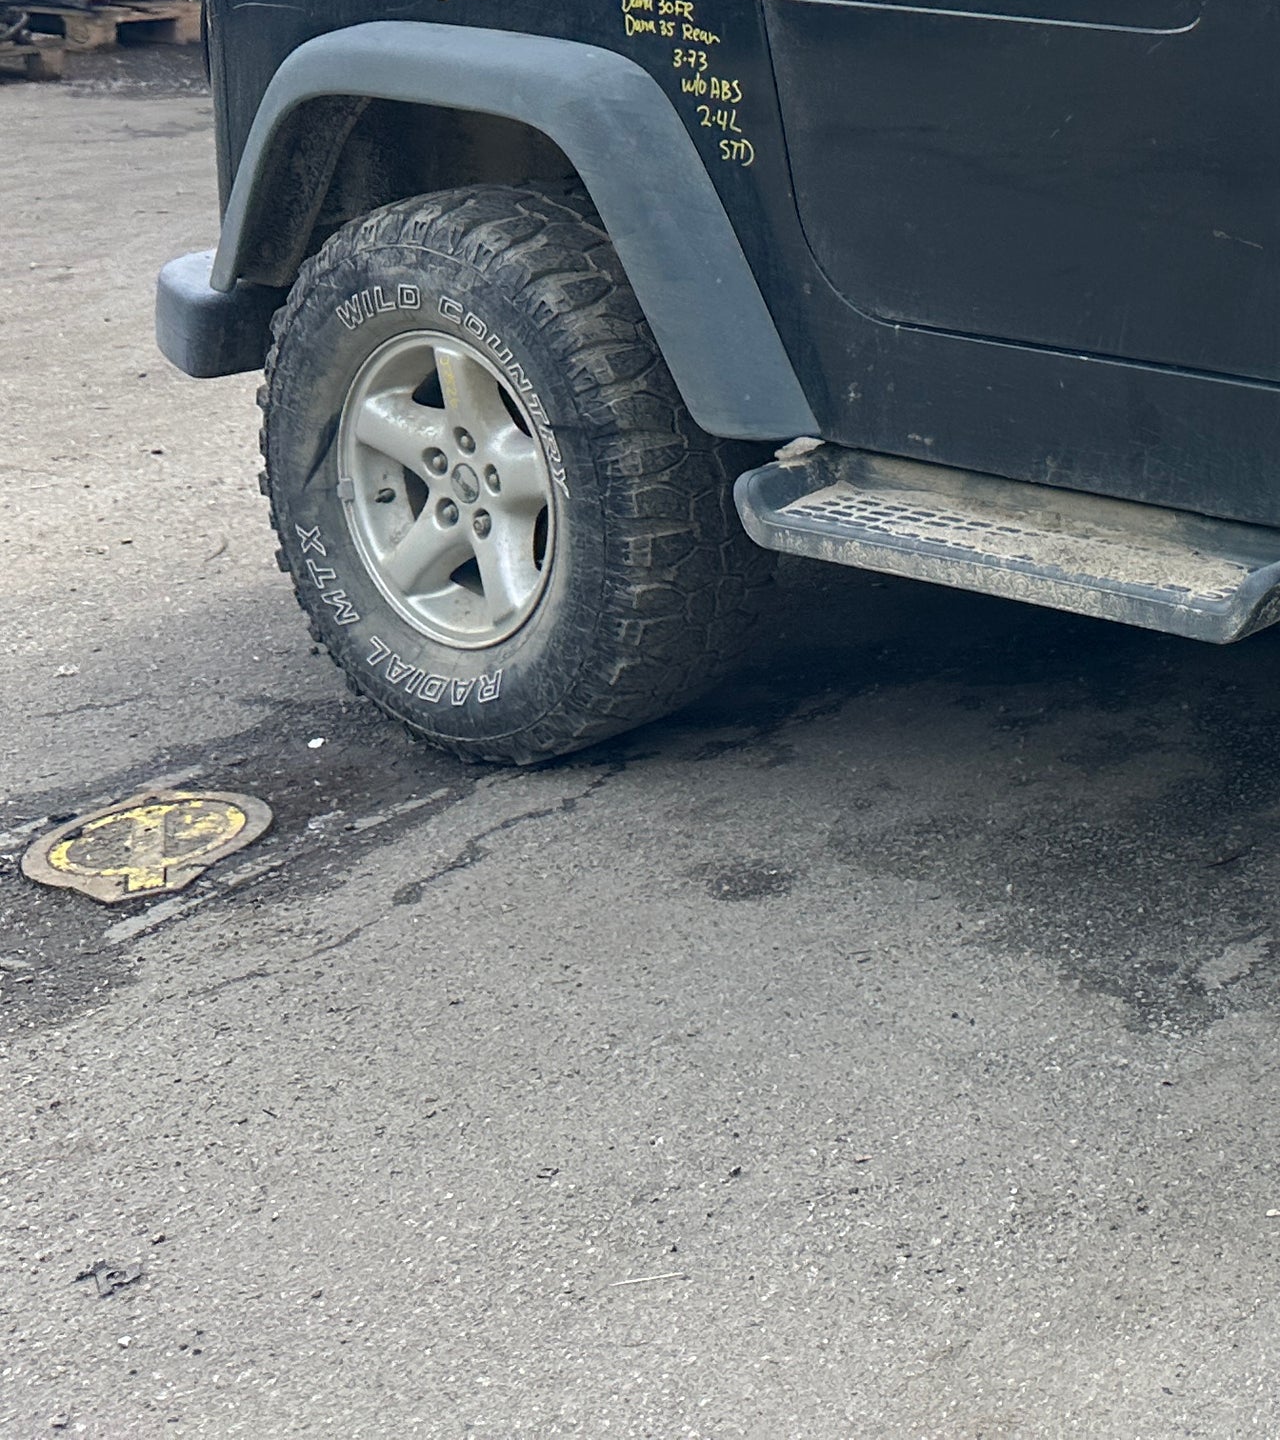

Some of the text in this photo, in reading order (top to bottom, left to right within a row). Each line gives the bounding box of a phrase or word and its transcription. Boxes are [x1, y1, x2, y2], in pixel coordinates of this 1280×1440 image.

[625, 14, 720, 44] Dana 35 Rear
[710, 76, 743, 103] ABS
[719, 138, 755, 167] STD
[335, 283, 571, 499] WILD COUNTRY
[294, 523, 503, 705] RADIAL MTX
